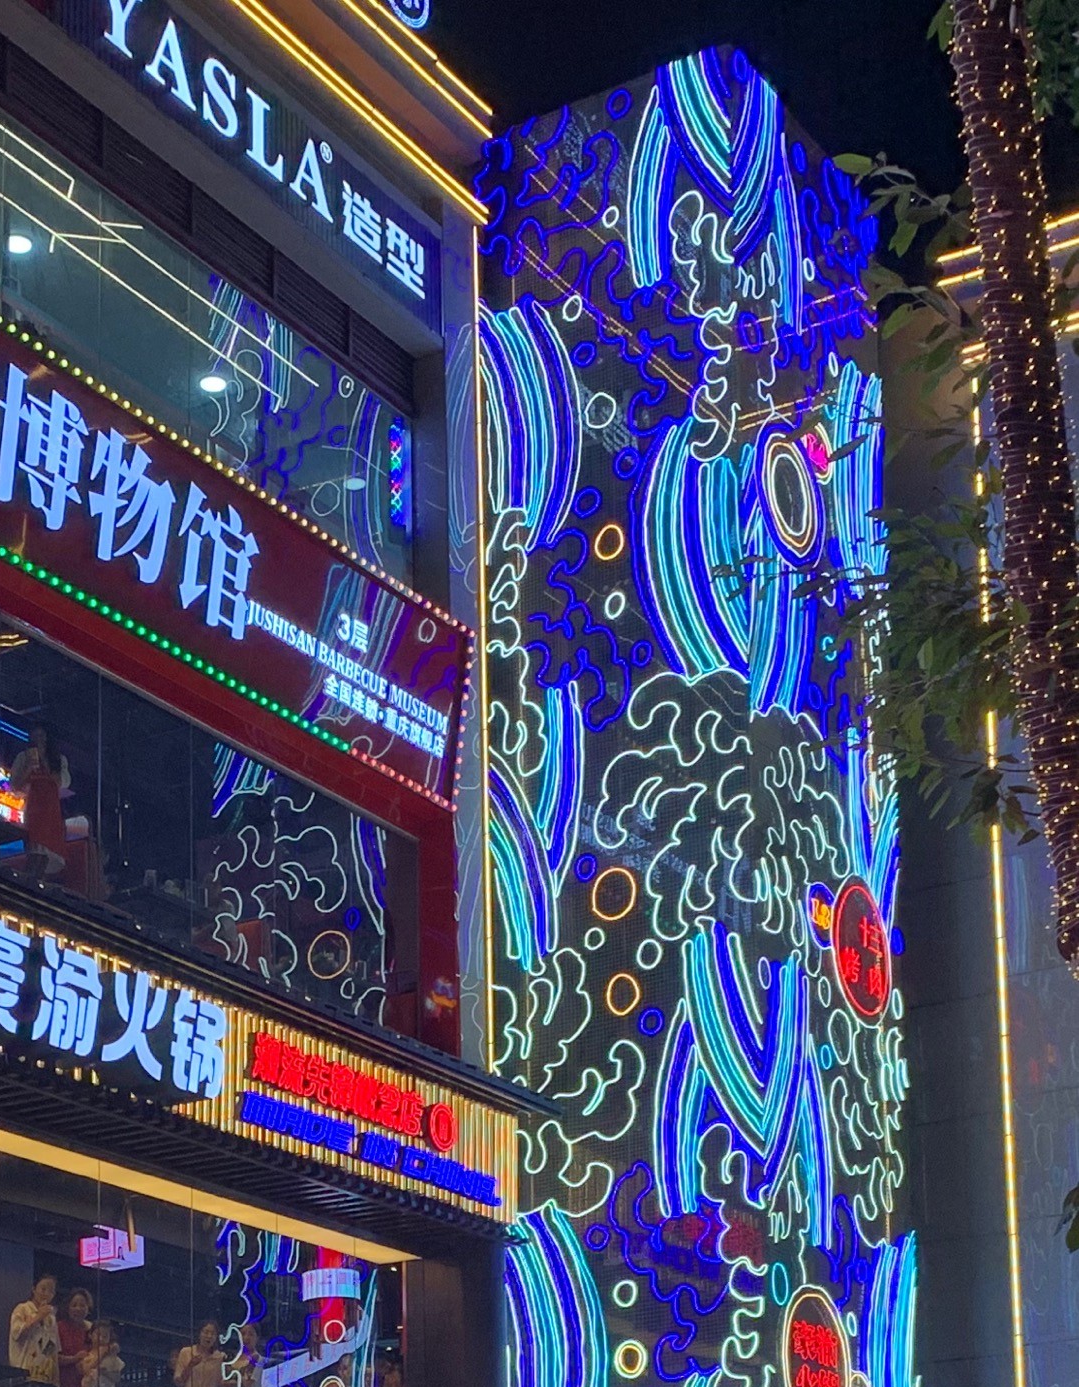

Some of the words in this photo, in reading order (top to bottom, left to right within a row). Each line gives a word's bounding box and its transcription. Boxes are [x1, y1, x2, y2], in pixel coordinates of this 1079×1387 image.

[104, 0, 334, 223] YASLA
[342, 180, 425, 299] 造型
[247, 600, 317, 657] JUSHISAN
[318, 641, 388, 700] BARBECUE
[389, 684, 448, 735] MUSEUM
[337, 613, 368, 653] 3层
[240, 1090, 356, 1153] MADE
[358, 1131, 399, 1168] IN
